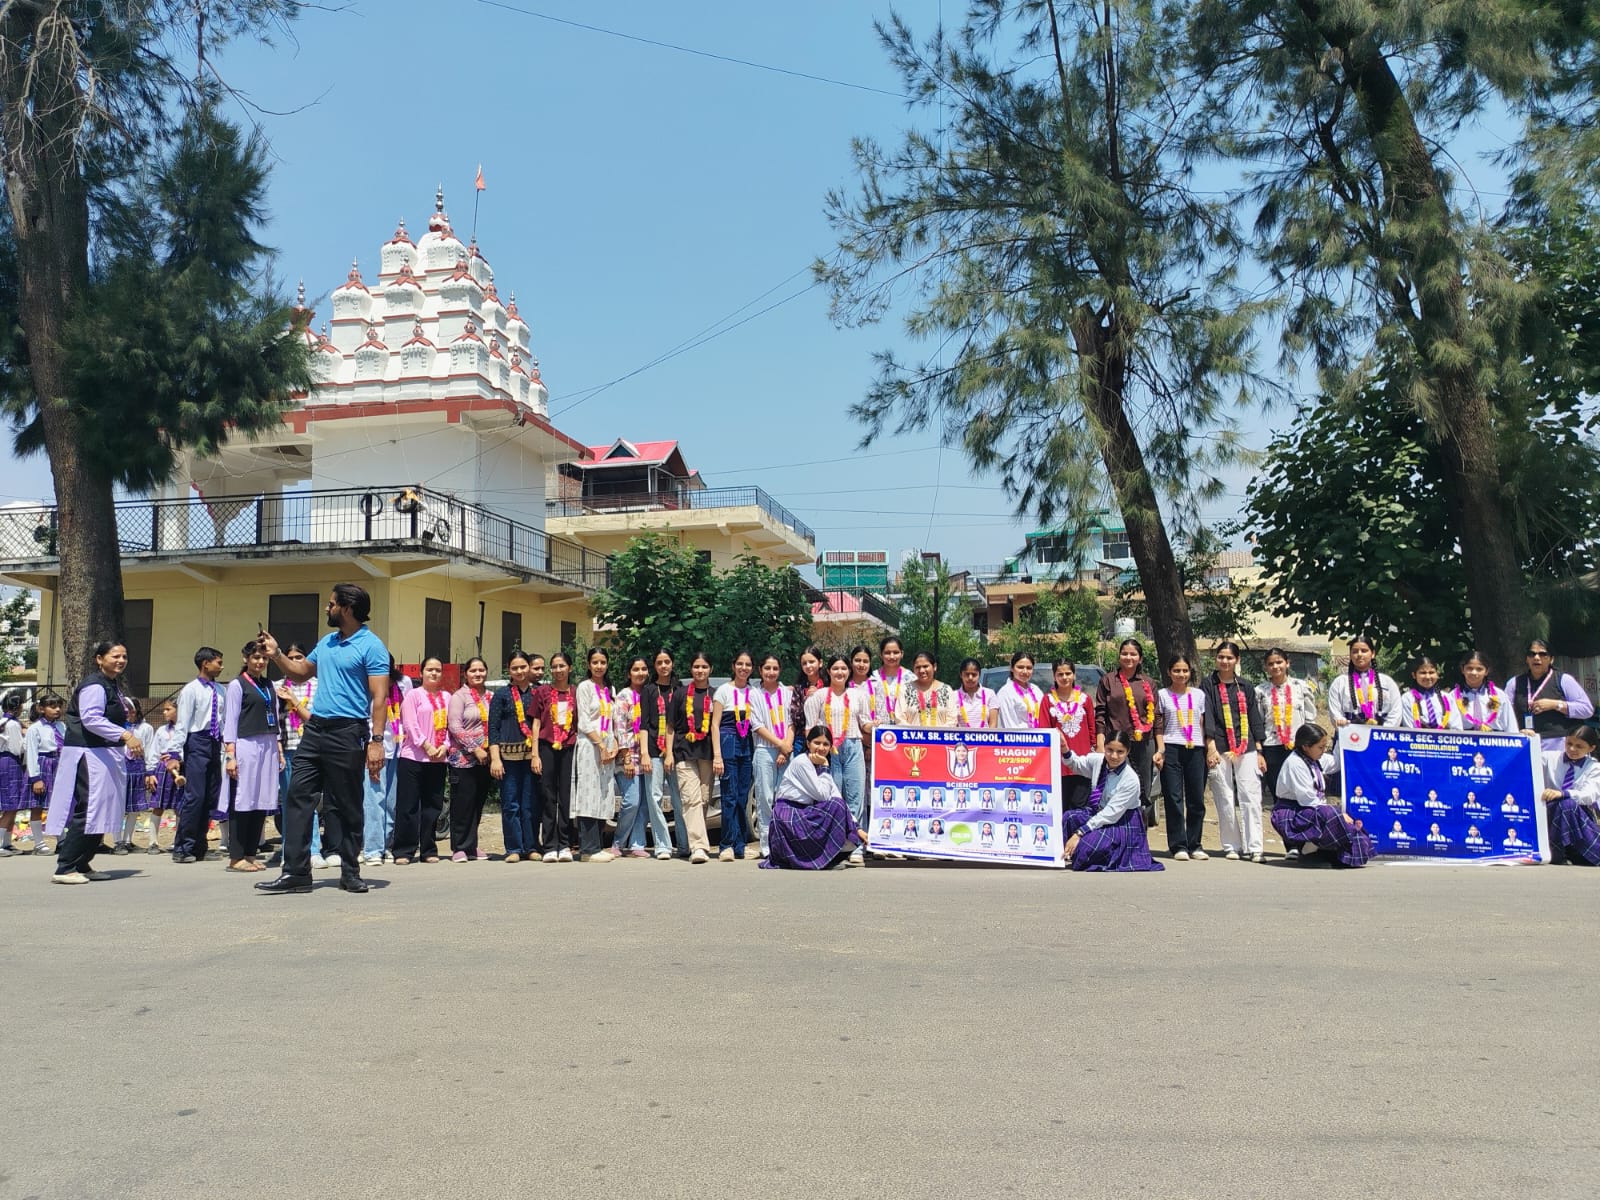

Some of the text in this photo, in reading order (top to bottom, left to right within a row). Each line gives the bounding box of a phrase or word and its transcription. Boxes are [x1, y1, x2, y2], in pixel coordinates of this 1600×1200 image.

[902, 731, 1044, 743] S.V.N. SR. SEC. SCHOOL, KUNIHAR
[1372, 731, 1523, 748] S.V.N. SR. SEC. SCHOOL, KUNIHAR
[993, 748, 1037, 757] SHAGUN
